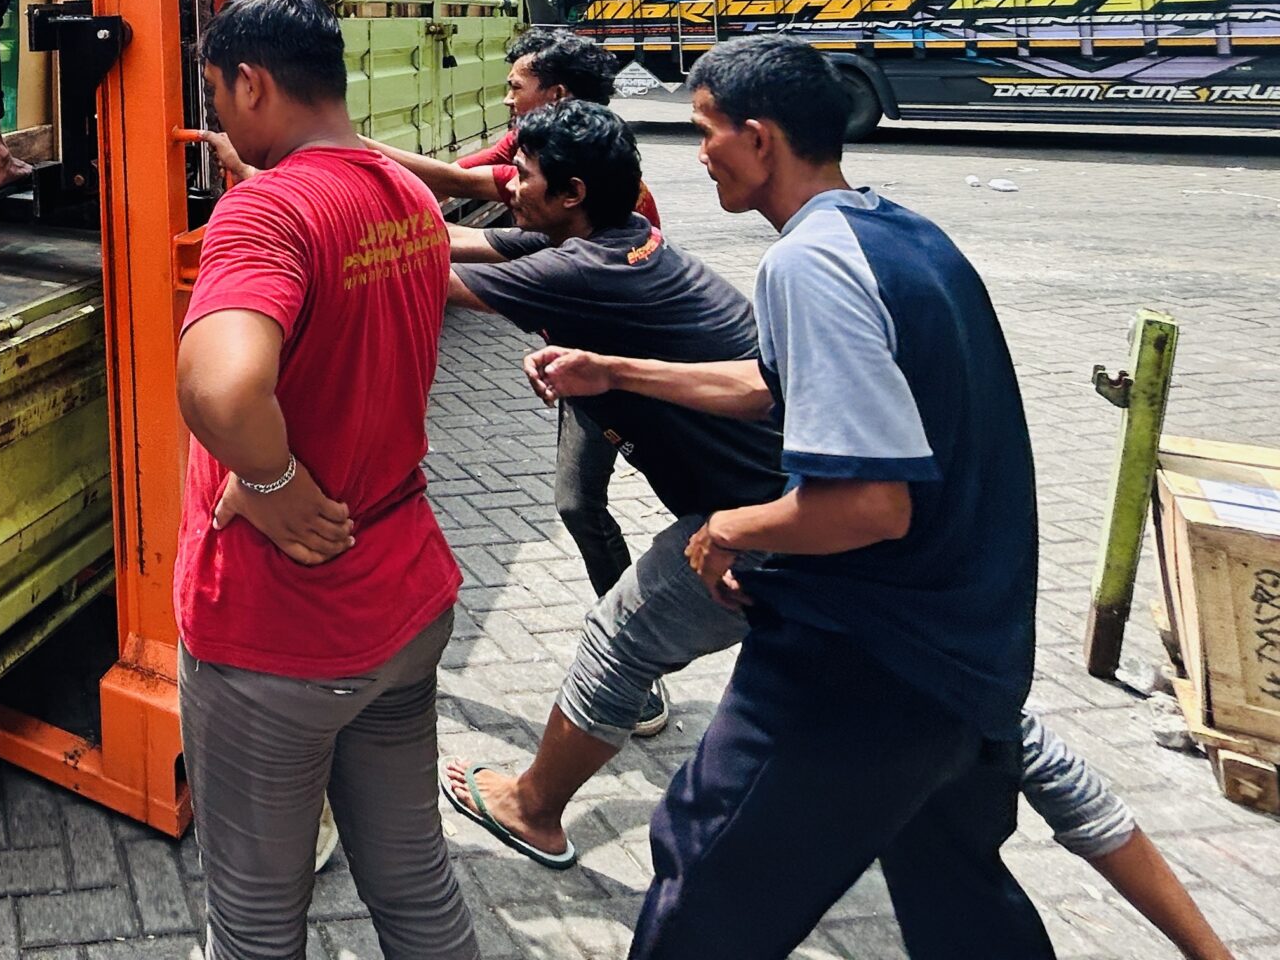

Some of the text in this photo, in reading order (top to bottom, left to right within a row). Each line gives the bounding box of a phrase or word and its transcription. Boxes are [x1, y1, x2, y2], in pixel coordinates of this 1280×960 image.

[993, 84, 1099, 101] DREAM
[1105, 84, 1199, 102] COME
[405, 227, 447, 256] BARAN
